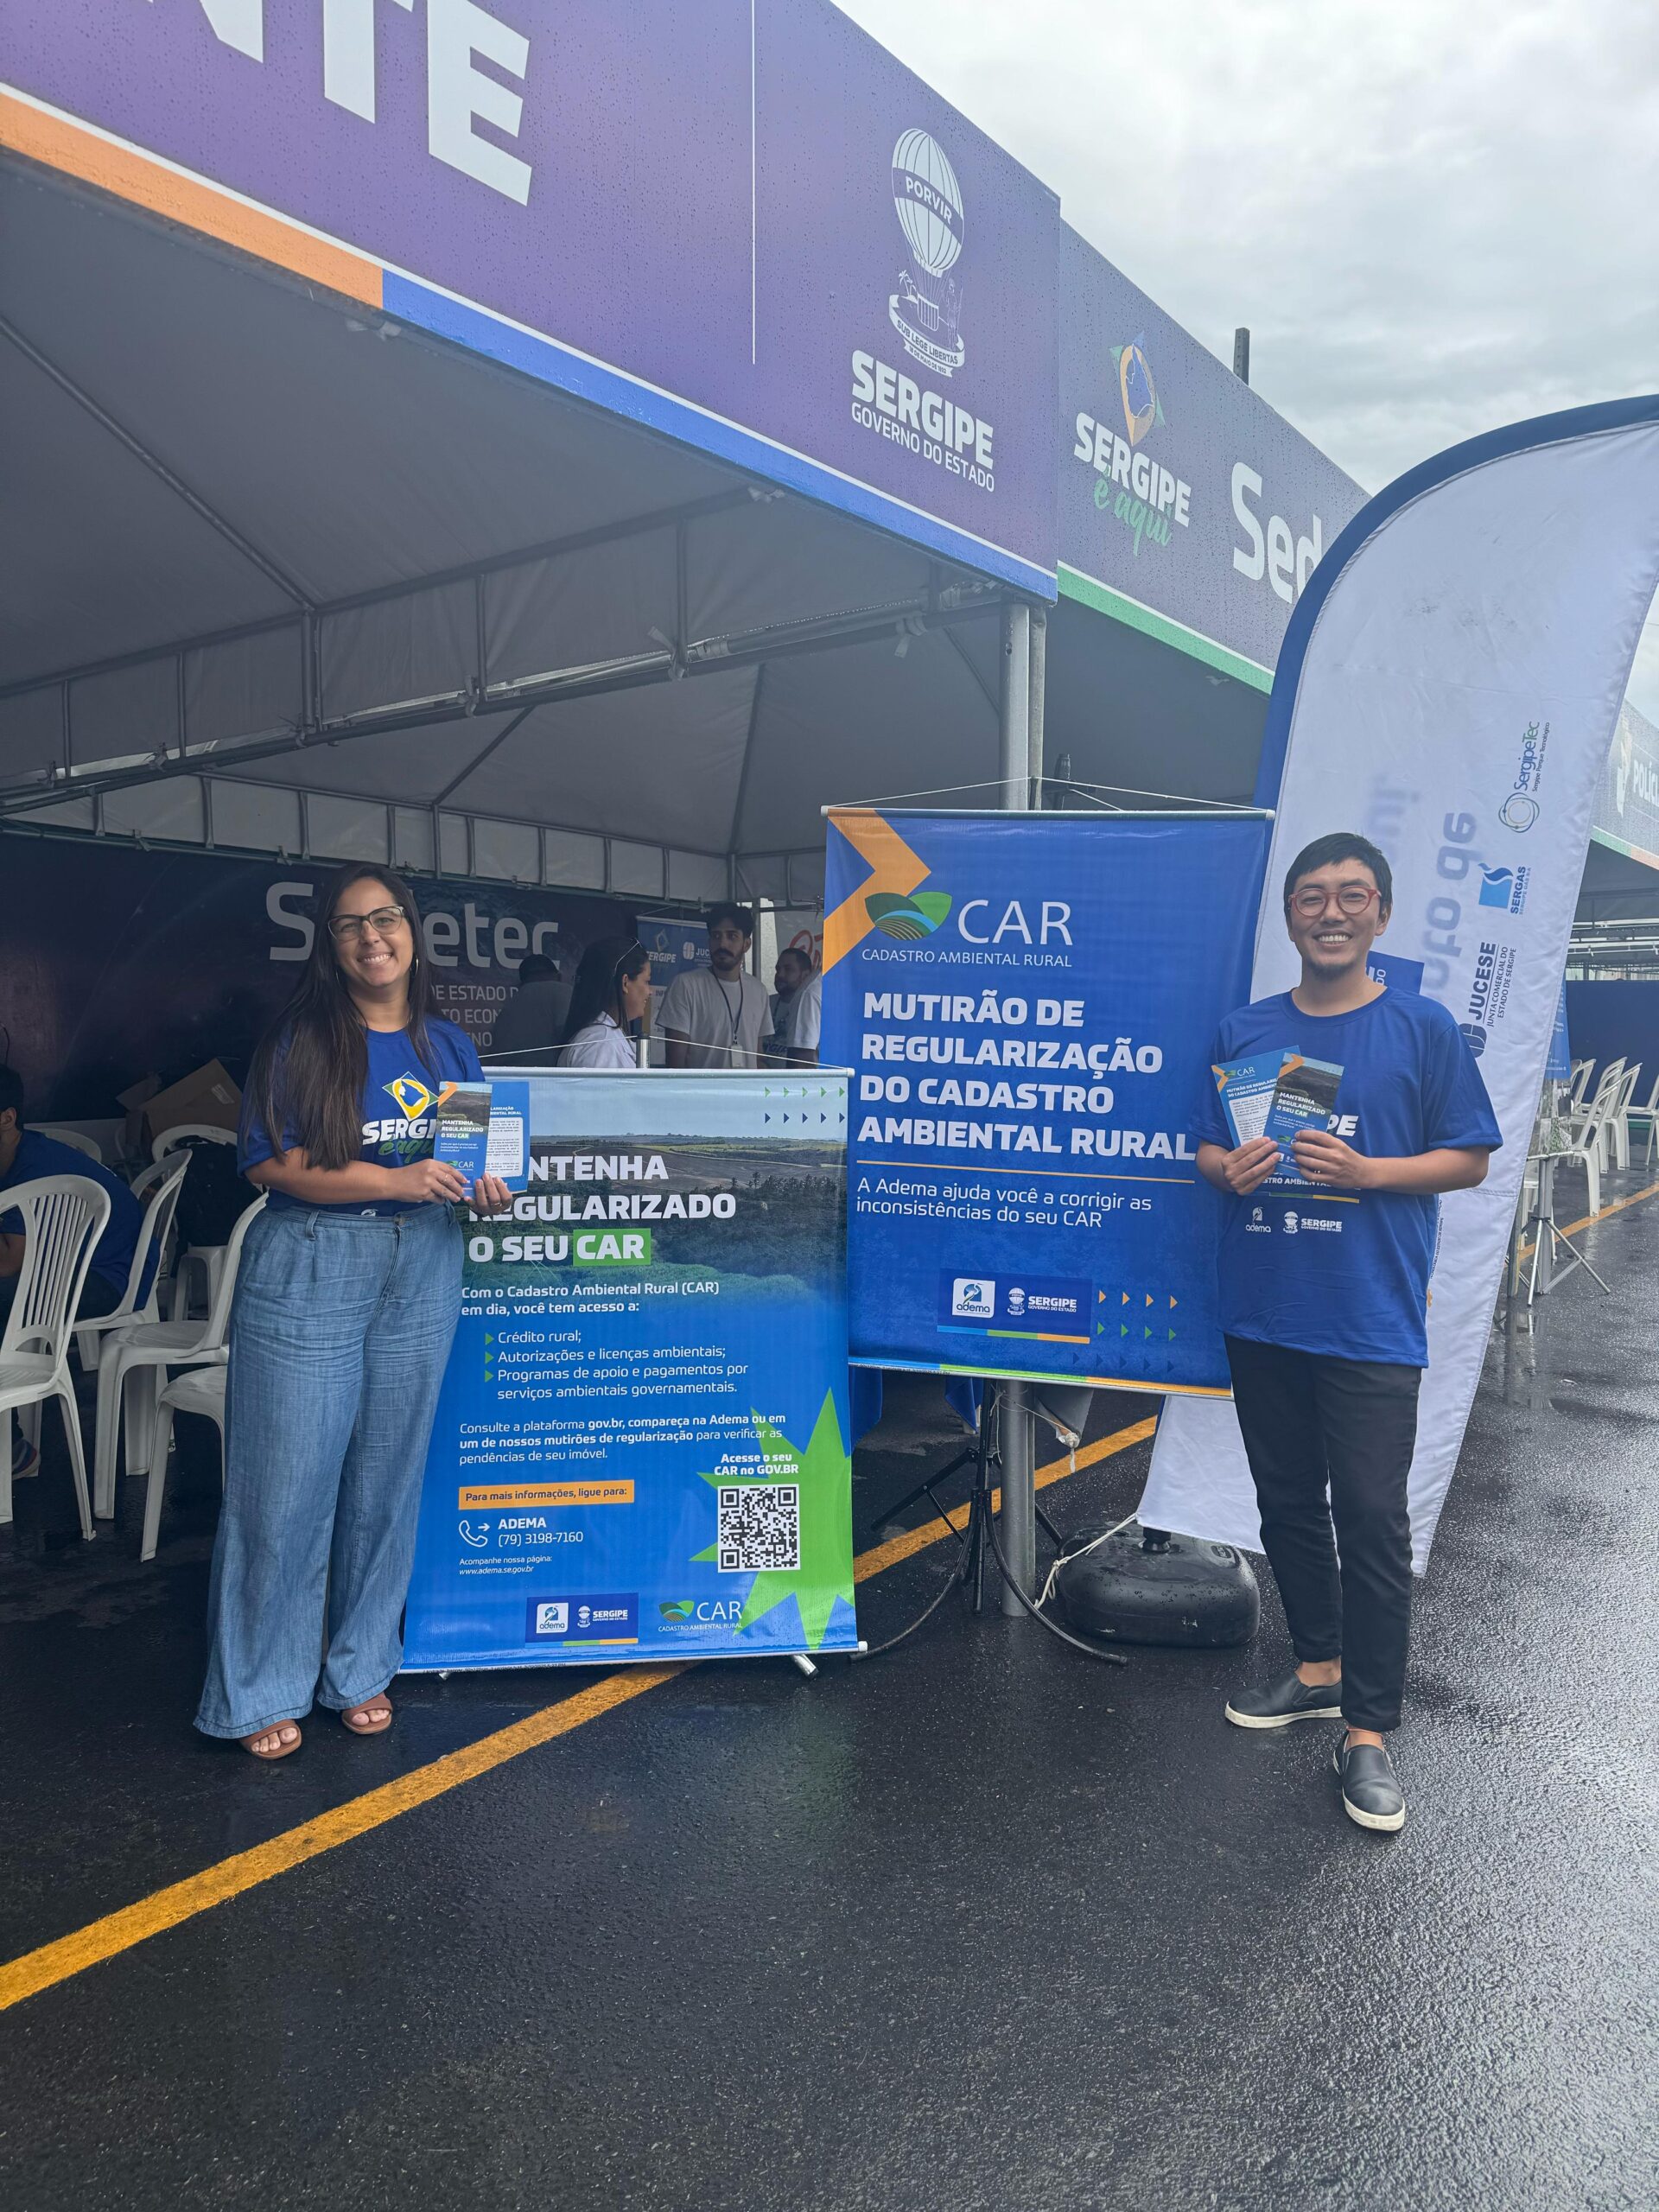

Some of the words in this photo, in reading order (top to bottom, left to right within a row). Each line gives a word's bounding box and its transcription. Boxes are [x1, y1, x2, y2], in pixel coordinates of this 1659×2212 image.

[905, 175, 952, 225] PORVIR
[897, 320, 911, 338] SUB
[912, 333, 928, 353] LEGE
[929, 346, 958, 365] LIBERTAS
[851, 349, 994, 470] SERGIPE
[851, 402, 920, 454] GOVERNO
[923, 439, 942, 465] DO
[945, 451, 995, 493] ESTADO
[1073, 412, 1192, 528] SERGIPE
[1114, 491, 1172, 557] aqui
[1540, 721, 1550, 753] Tecnológico
[1514, 721, 1540, 791] SergipeTec
[1536, 753, 1546, 772] Parque
[1532, 772, 1541, 792] Sergipe
[1510, 866, 1526, 914] SERGAS
[957, 899, 1073, 946] CAR
[646, 950, 677, 963] ERGIPE
[861, 949, 935, 963] CADASTRO
[938, 951, 1020, 966] AMBIENTAL
[1023, 954, 1072, 968] RURAL
[1500, 946, 1509, 958] DO
[1506, 948, 1516, 977] SERGIPE
[1468, 942, 1497, 1020] JUCESE
[1491, 960, 1506, 1002] COMERCIAL
[1503, 977, 1511, 988] DE
[448, 985, 506, 1001] ESTADO
[864, 988, 1028, 1026] MUTIRÃO
[1036, 999, 1084, 1027] DE
[1497, 989, 1509, 1018] ESTADO
[1486, 1003, 1497, 1027] JUNTA
[861, 1033, 1163, 1079] REGULARIZAÇÃO
[1236, 1066, 1255, 1077] CAR
[860, 1074, 910, 1103] DO
[918, 1077, 1115, 1114] CADASTRO
[1279, 1091, 1315, 1105] MANTENHA
[1278, 1098, 1325, 1115] REGULARIZADO
[1294, 1109, 1308, 1117] CAR
[856, 1116, 1063, 1153] AMBIENTAL
[1071, 1127, 1197, 1161] RURAL
[528, 1154, 669, 1181] NTENHA
[856, 1177, 871, 1192] A
[875, 1178, 938, 1198] Adema
[943, 1182, 991, 1202] ajuda
[996, 1187, 1039, 1204] você
[1043, 1192, 1054, 1205] a
[1060, 1191, 1125, 1211] corrigir
[1129, 1198, 1152, 1211] as
[856, 1196, 992, 1221] inconsistências
[997, 1205, 1020, 1224] do
[1025, 1211, 1058, 1225] seu
[1063, 1210, 1103, 1228] CAR
[1245, 1224, 1271, 1233] adema
[1301, 1218, 1343, 1229] SERGIPE
[468, 1236, 494, 1262] O
[502, 1235, 569, 1262] SEU
[576, 1233, 645, 1261] CAR
[461, 1287, 491, 1299] Com
[495, 1289, 504, 1298] o
[507, 1285, 569, 1298] Cadastro
[571, 1282, 641, 1296] Ambiental
[644, 1282, 678, 1294] Rural
[681, 1281, 720, 1295] (CAR)
[461, 1305, 482, 1316] em
[486, 1302, 510, 1318] dia,
[513, 1301, 546, 1314] você
[549, 1303, 574, 1314] tem
[578, 1302, 625, 1313] acesso
[627, 1302, 640, 1312] a:
[957, 1303, 990, 1313] adema
[1028, 1296, 1077, 1308] SERGIPE
[498, 1331, 545, 1344] Crédito
[549, 1330, 582, 1344] rural;
[498, 1350, 584, 1364] Autorizações
[588, 1351, 595, 1360] e
[599, 1347, 649, 1363] licenças
[652, 1344, 726, 1359] ambientais;
[498, 1368, 570, 1383] Programas
[574, 1367, 589, 1379] de
[593, 1365, 629, 1381] apoio
[632, 1368, 640, 1377] e
[644, 1364, 723, 1380] pagamentos
[727, 1363, 748, 1377] por
[497, 1387, 553, 1402] serviços
[556, 1384, 627, 1398] ambientais
[632, 1381, 738, 1398] governamentais.
[460, 1422, 511, 1434] Consulte
[523, 1420, 585, 1433] plataforma
[588, 1418, 626, 1431] gov.br,
[628, 1416, 690, 1429] compareça
[692, 1416, 707, 1425] na
[709, 1414, 749, 1425] Adema
[752, 1415, 766, 1424] ou
[768, 1414, 786, 1423] em
[460, 1440, 479, 1449] um
[481, 1437, 496, 1447] de
[499, 1438, 542, 1447] nossos
[544, 1433, 596, 1446] mutirões
[599, 1433, 613, 1443] de
[616, 1430, 694, 1445] regularização
[696, 1431, 721, 1441] para
[723, 1428, 766, 1439] verificar
[769, 1429, 783, 1439] as
[460, 1452, 525, 1466] pendências
[528, 1451, 543, 1461] de
[545, 1452, 566, 1461] seu
[569, 1447, 608, 1460] imóvel.
[721, 1453, 760, 1464] Acesse
[762, 1454, 769, 1463] o
[772, 1453, 792, 1462] seu
[714, 1465, 738, 1476] CAR
[740, 1466, 754, 1475] no
[757, 1464, 799, 1475] GOV.BR
[466, 1492, 487, 1502] Para
[489, 1491, 512, 1501] mais
[515, 1489, 576, 1501] informações,
[578, 1488, 601, 1498] ligue
[603, 1488, 627, 1498] para:
[498, 1517, 547, 1530] ADEMA
[498, 1534, 522, 1548] (79)
[524, 1531, 584, 1545] 3198-7160
[459, 1556, 502, 1567] Acompanhe
[526, 1554, 552, 1565] página:
[459, 1566, 534, 1575] www.adema.se.gov.br
[593, 1610, 628, 1618] SERGIPE
[696, 1601, 743, 1622] CAR
